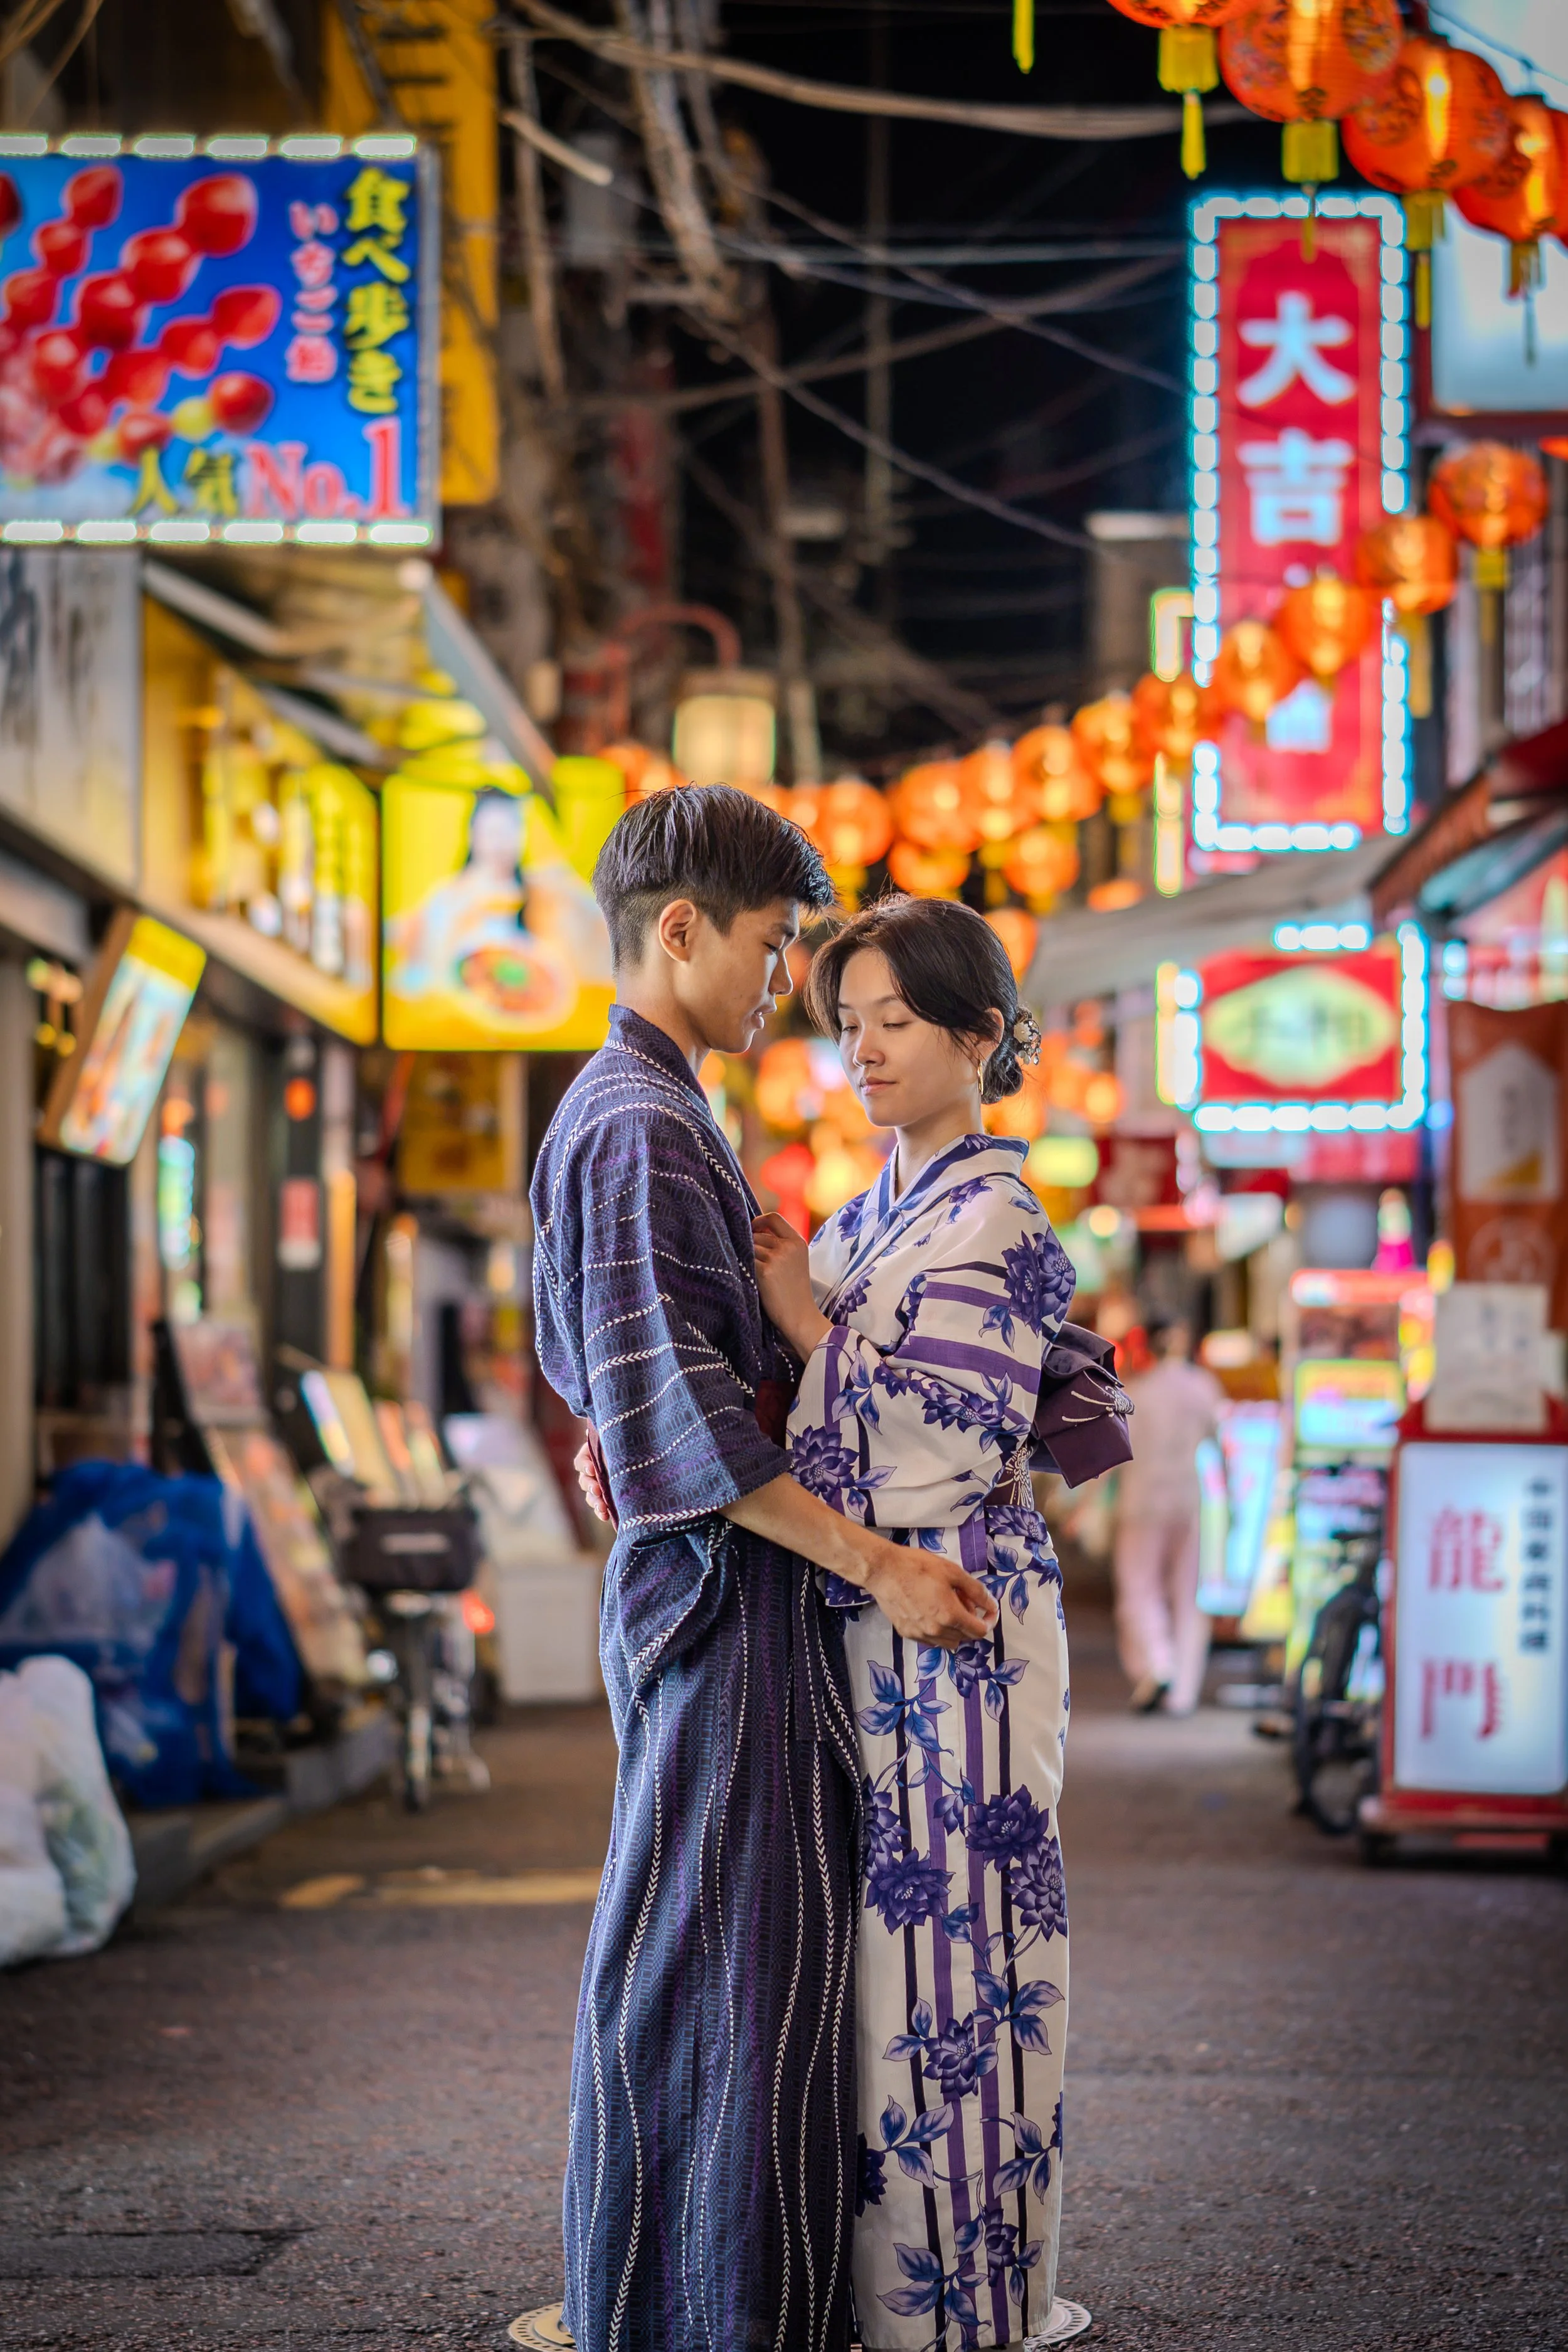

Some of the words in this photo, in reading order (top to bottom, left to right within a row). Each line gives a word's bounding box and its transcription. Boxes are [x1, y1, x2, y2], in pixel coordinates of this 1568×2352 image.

[342, 166, 410, 414] 食べ歩き
[245, 416, 411, 519] No.1
